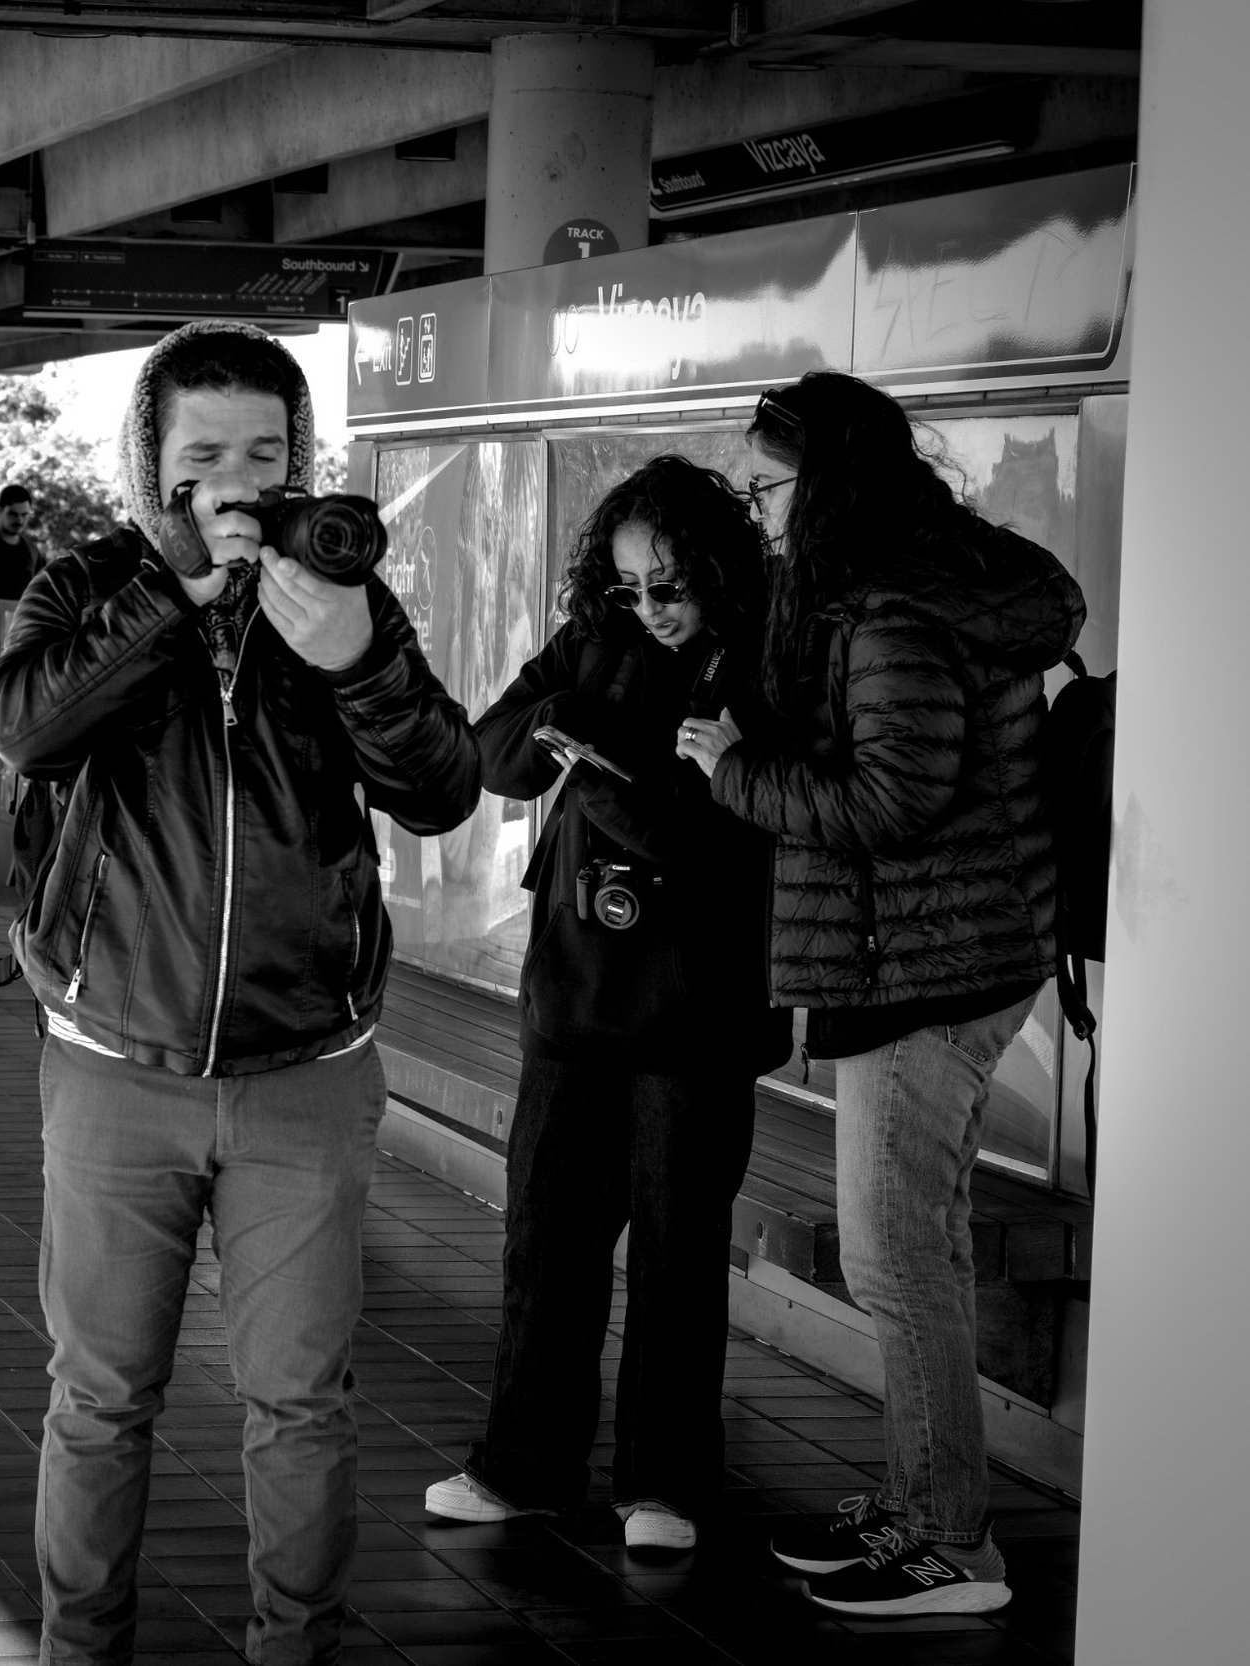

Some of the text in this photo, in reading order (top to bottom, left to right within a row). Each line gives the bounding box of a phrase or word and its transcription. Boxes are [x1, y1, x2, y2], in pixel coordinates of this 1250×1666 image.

[743, 133, 826, 174] Vizcaya
[658, 170, 706, 194] Southbound
[566, 226, 605, 240] TRACK
[578, 241, 590, 259] 1
[281, 257, 356, 272] Southbound
[336, 295, 346, 314] 1
[385, 547, 416, 600] Fight
[703, 647, 725, 682] Canon
[902, 1556, 956, 1586] N
